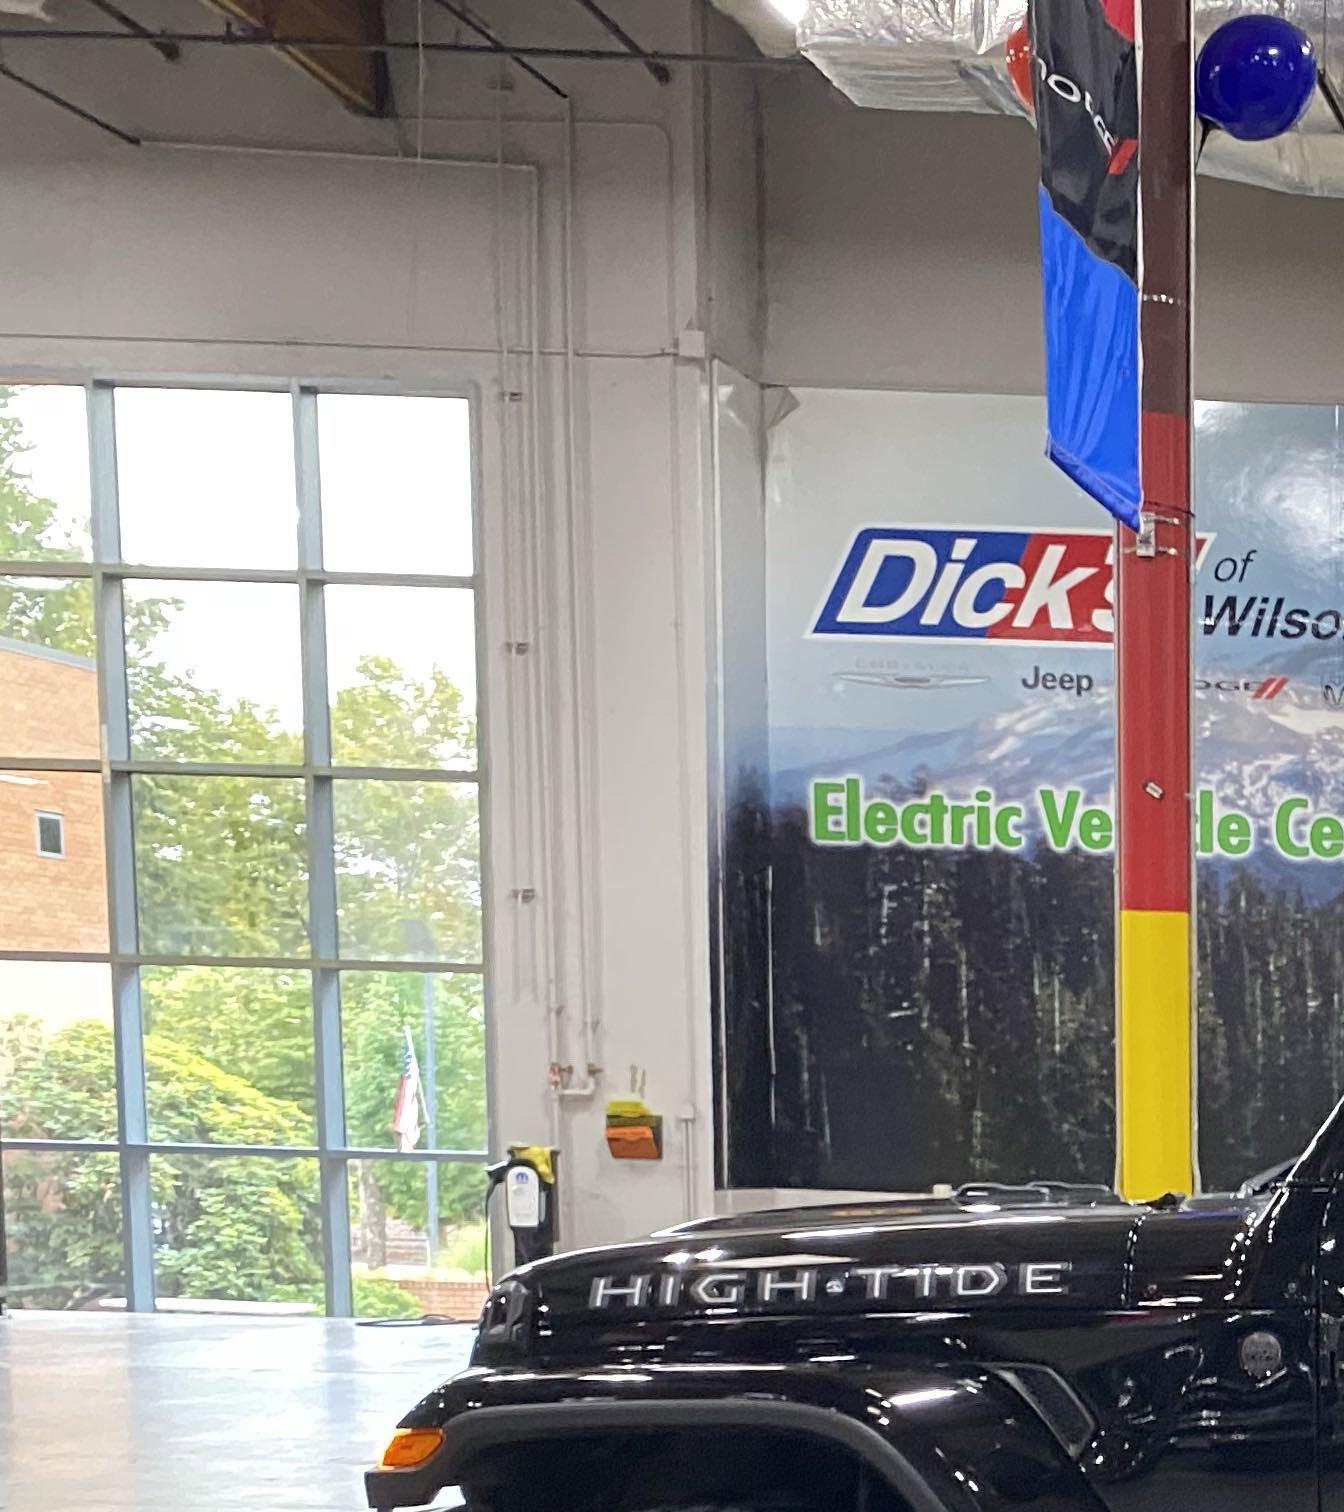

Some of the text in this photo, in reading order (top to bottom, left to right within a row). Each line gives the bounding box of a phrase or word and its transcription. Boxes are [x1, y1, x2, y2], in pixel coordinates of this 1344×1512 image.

[1214, 550, 1257, 583] of
[1021, 665, 1094, 696] Jeep
[813, 778, 1023, 847] Electric
[1039, 788, 1251, 856] Vele
[589, 1269, 820, 1308] HIGH
